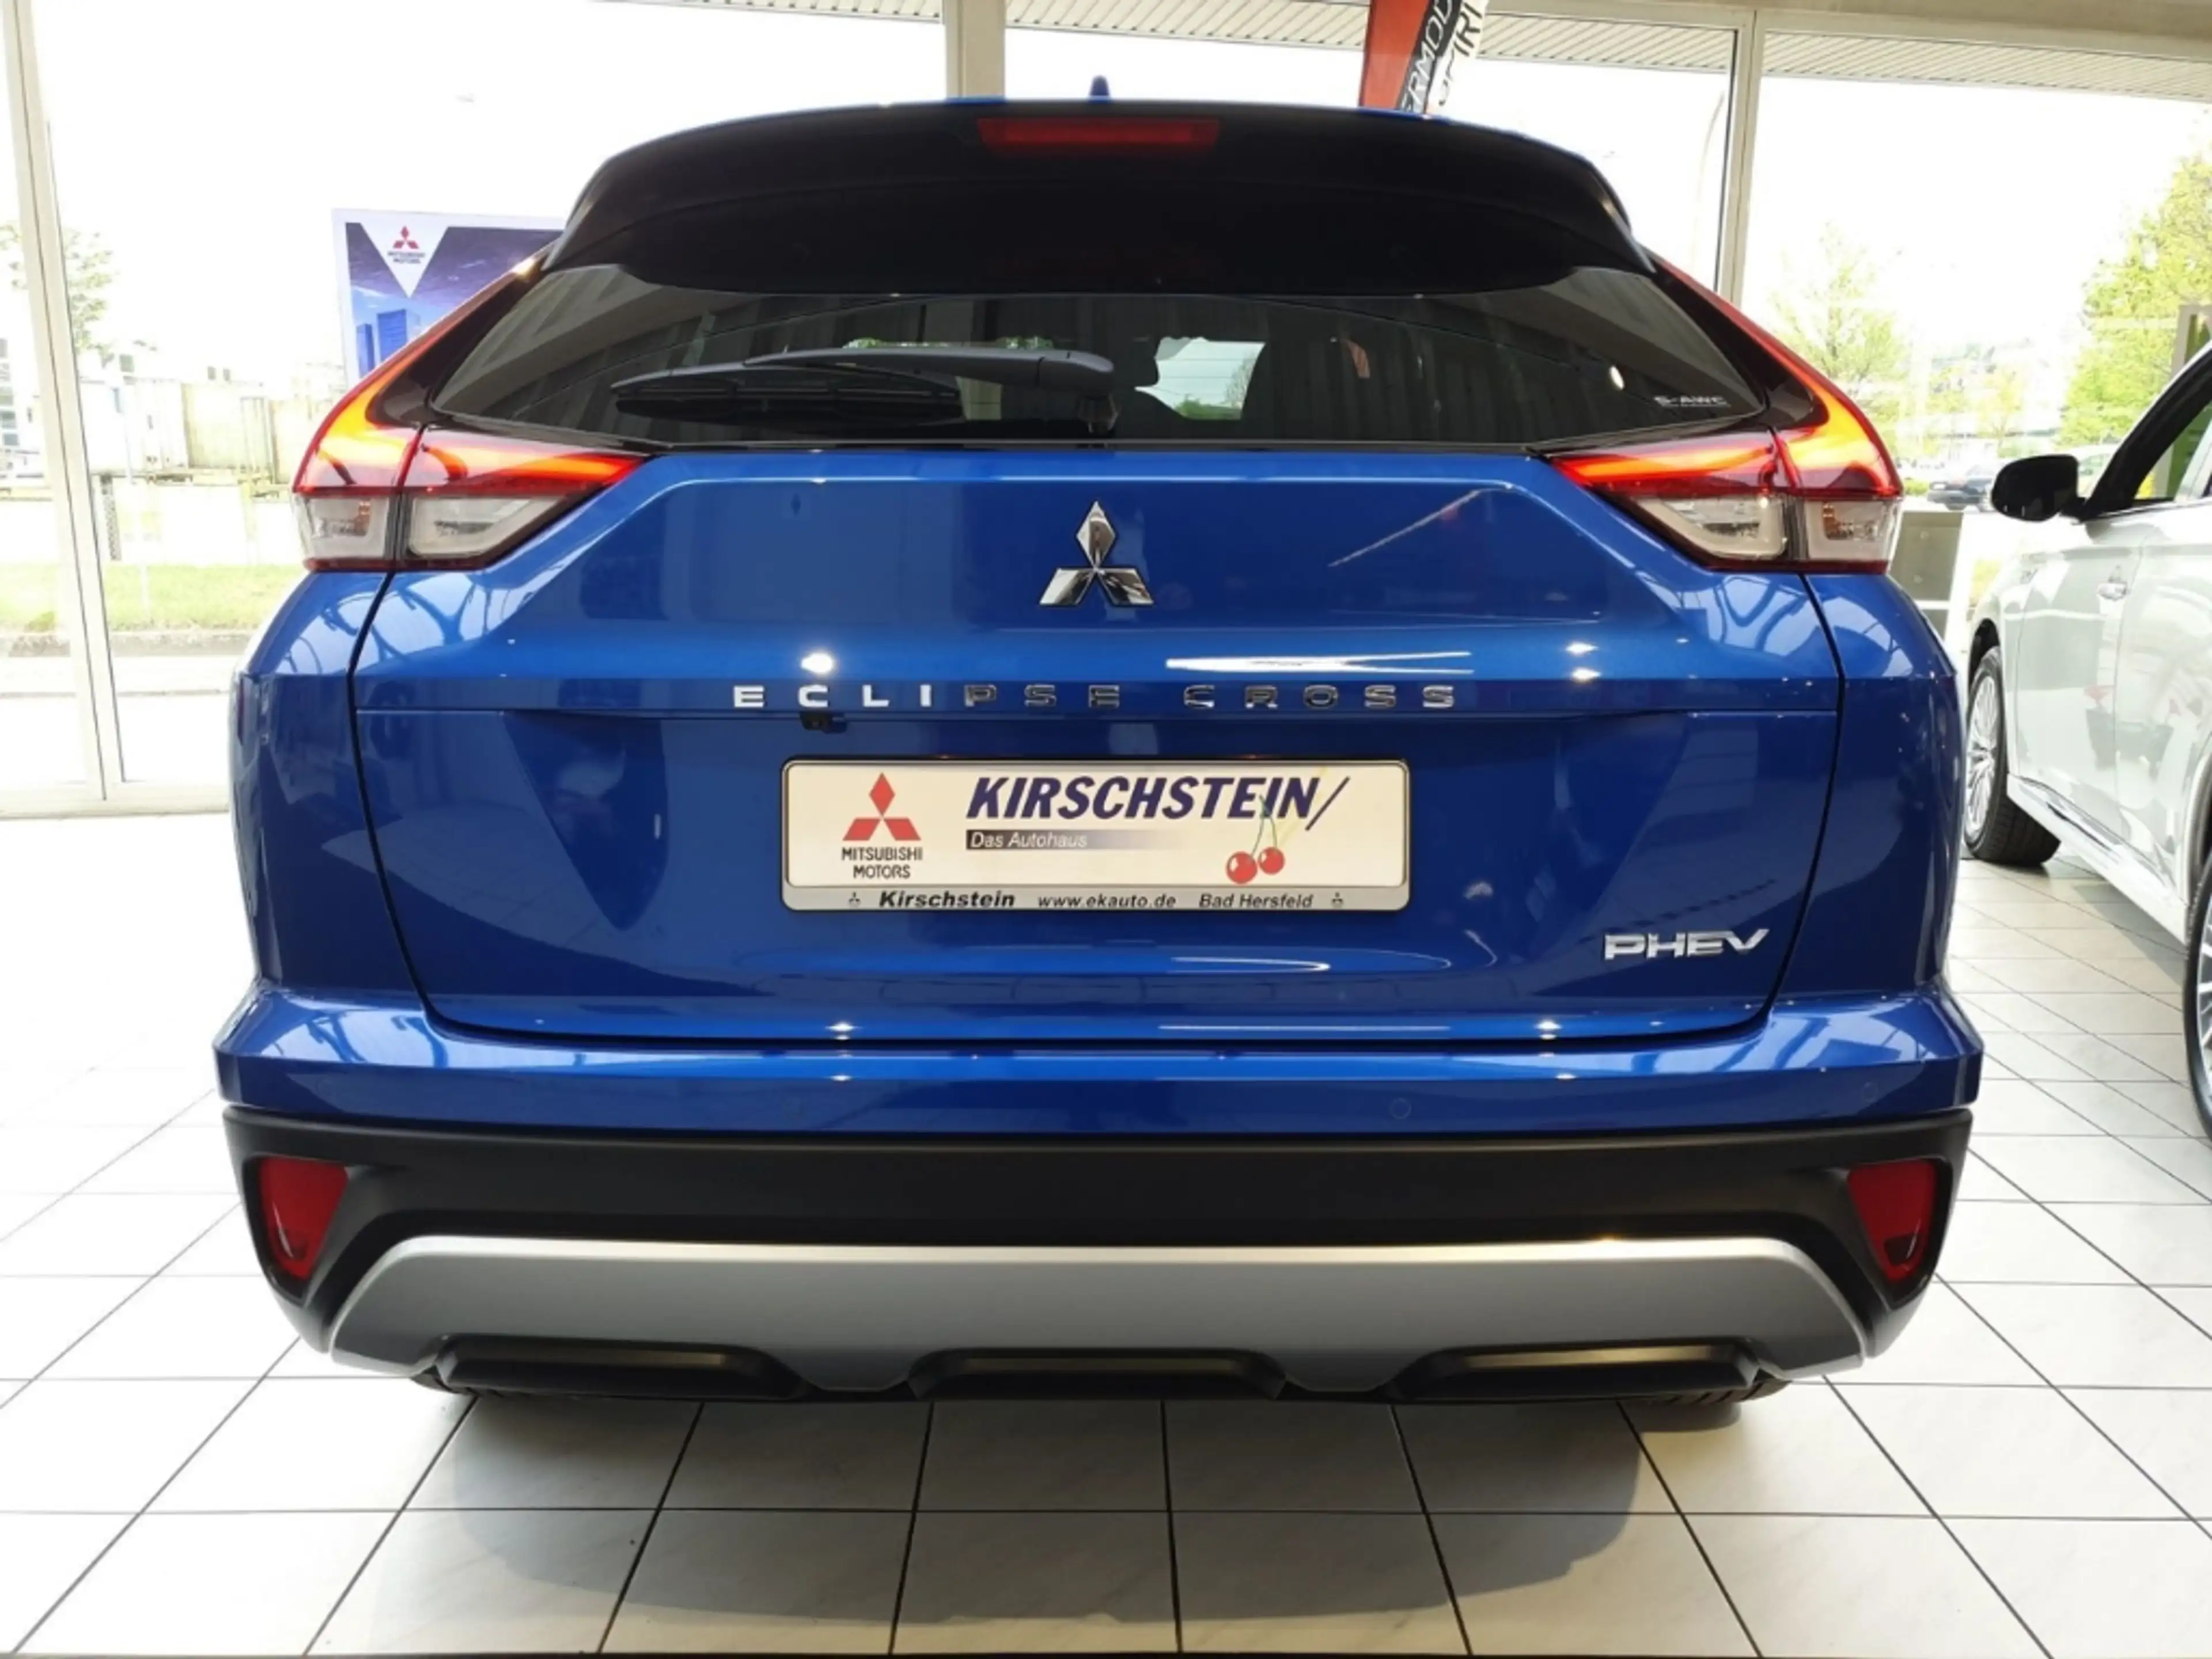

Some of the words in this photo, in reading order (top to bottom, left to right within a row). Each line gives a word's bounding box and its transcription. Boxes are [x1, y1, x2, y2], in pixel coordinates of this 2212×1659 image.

[733, 685, 1120, 708] ECLIPSE
[1184, 685, 1454, 709] CROSS
[970, 832, 1003, 848] Das
[1007, 831, 1088, 848] Autohaus
[841, 847, 923, 861] MITSUBISHI
[853, 865, 910, 879] MOTORS
[879, 891, 1015, 908] Kirschstein
[1038, 893, 1176, 908] www.ekauto.de
[1199, 893, 1234, 908] Bad
[1239, 893, 1314, 908] Hersfeld
[1604, 929, 1770, 960] PHEV
